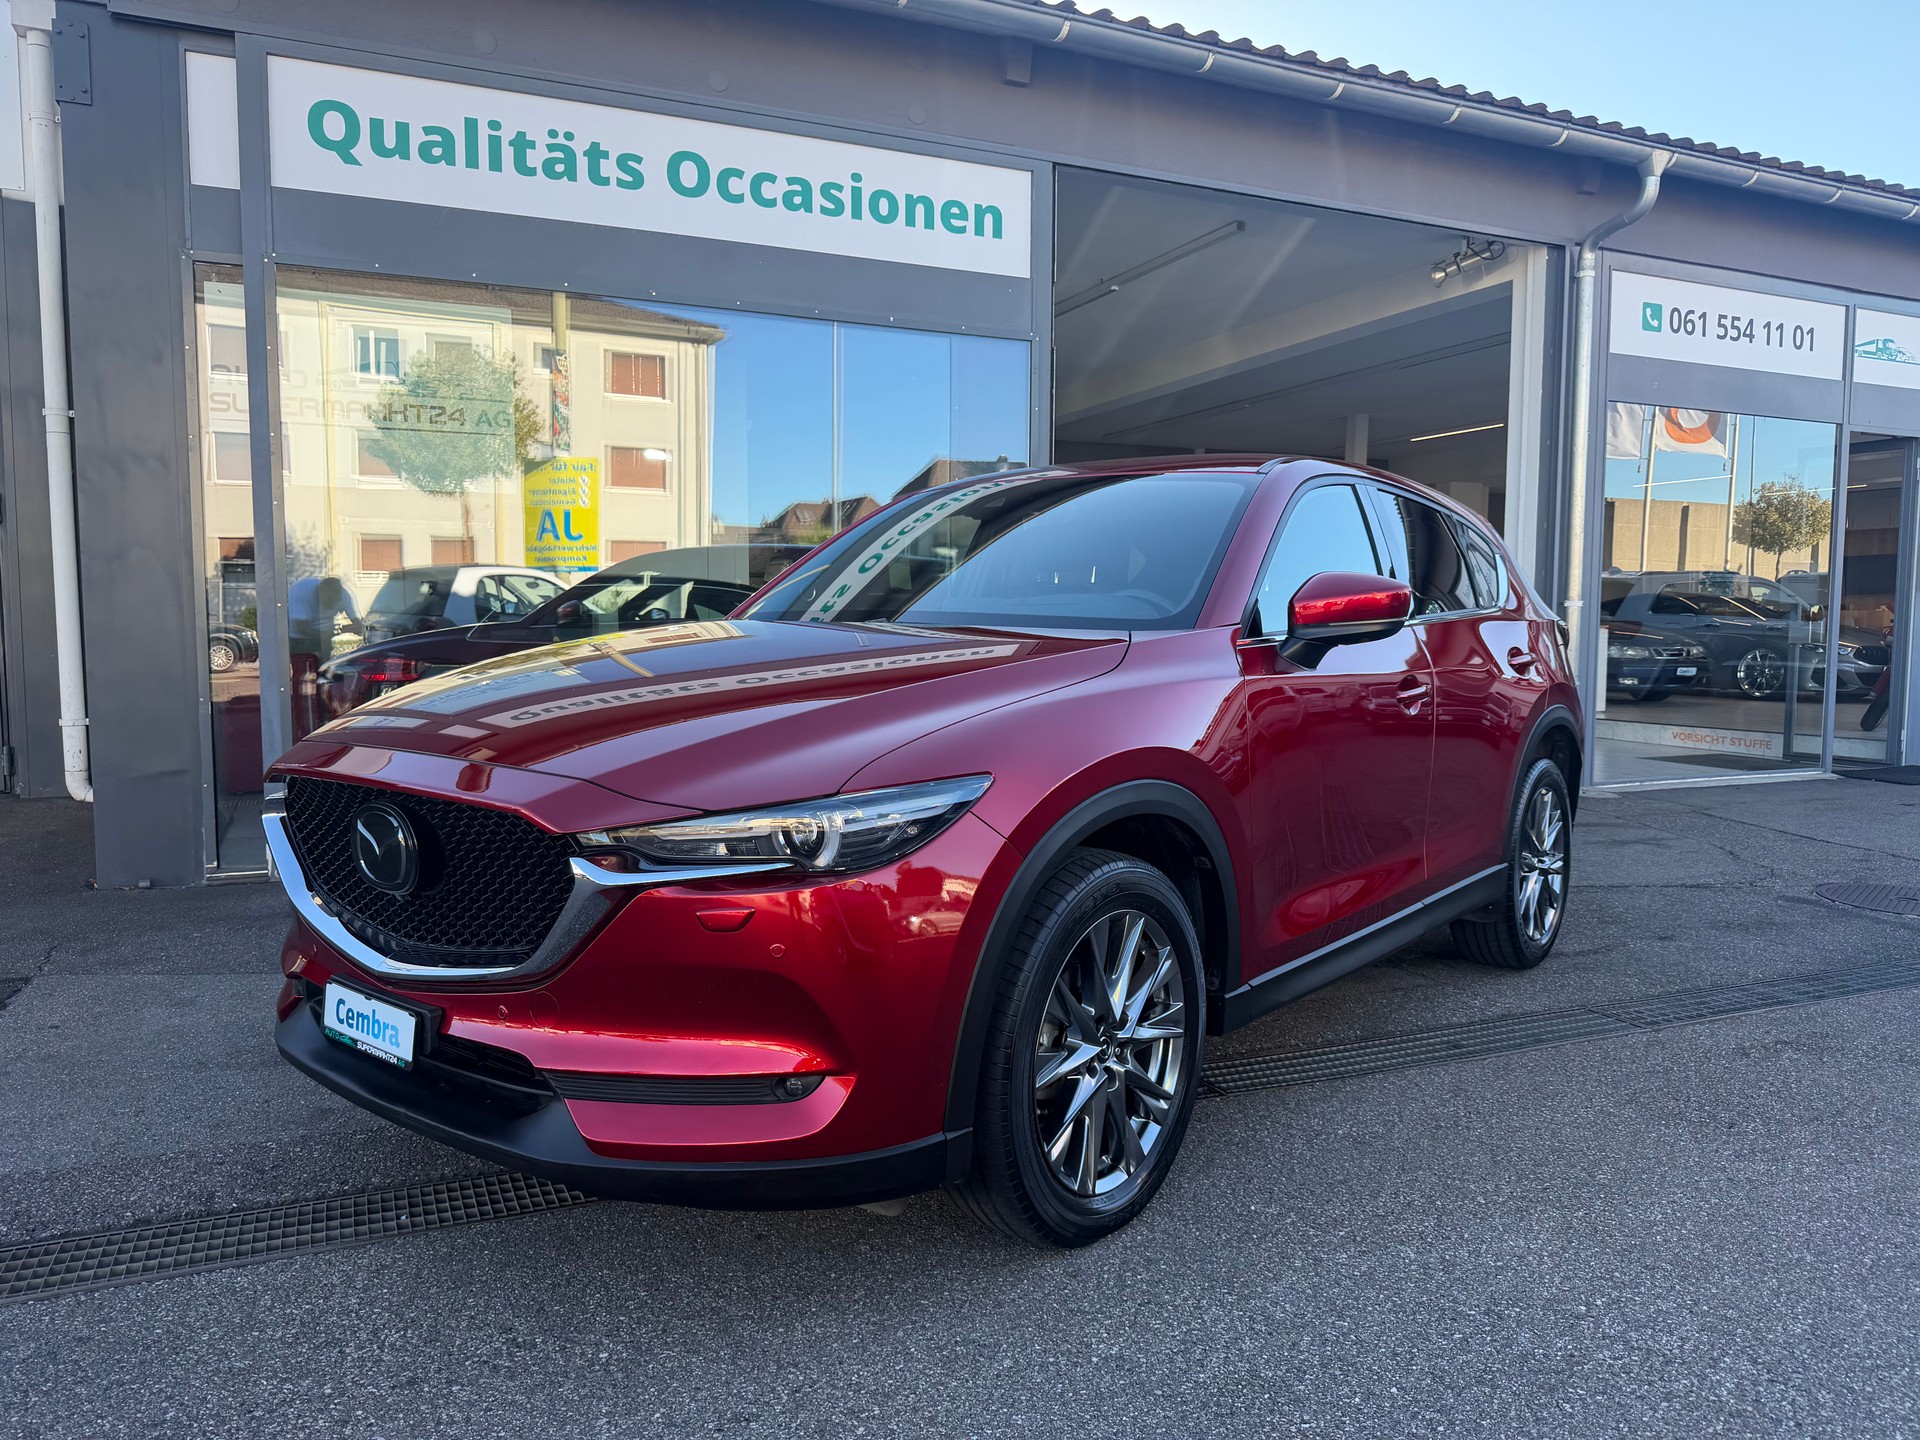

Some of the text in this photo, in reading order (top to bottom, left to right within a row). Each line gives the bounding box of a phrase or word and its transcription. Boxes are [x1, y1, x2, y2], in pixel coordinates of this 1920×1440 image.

[307, 99, 1003, 240] Qualitäts Occasionen
[1668, 306, 1815, 352] 061 554 11 01
[475, 409, 512, 428] AG
[1671, 731, 1773, 750] VORSICHT STUFFE
[324, 1027, 340, 1040] AUTO
[335, 997, 400, 1048] Cembra
